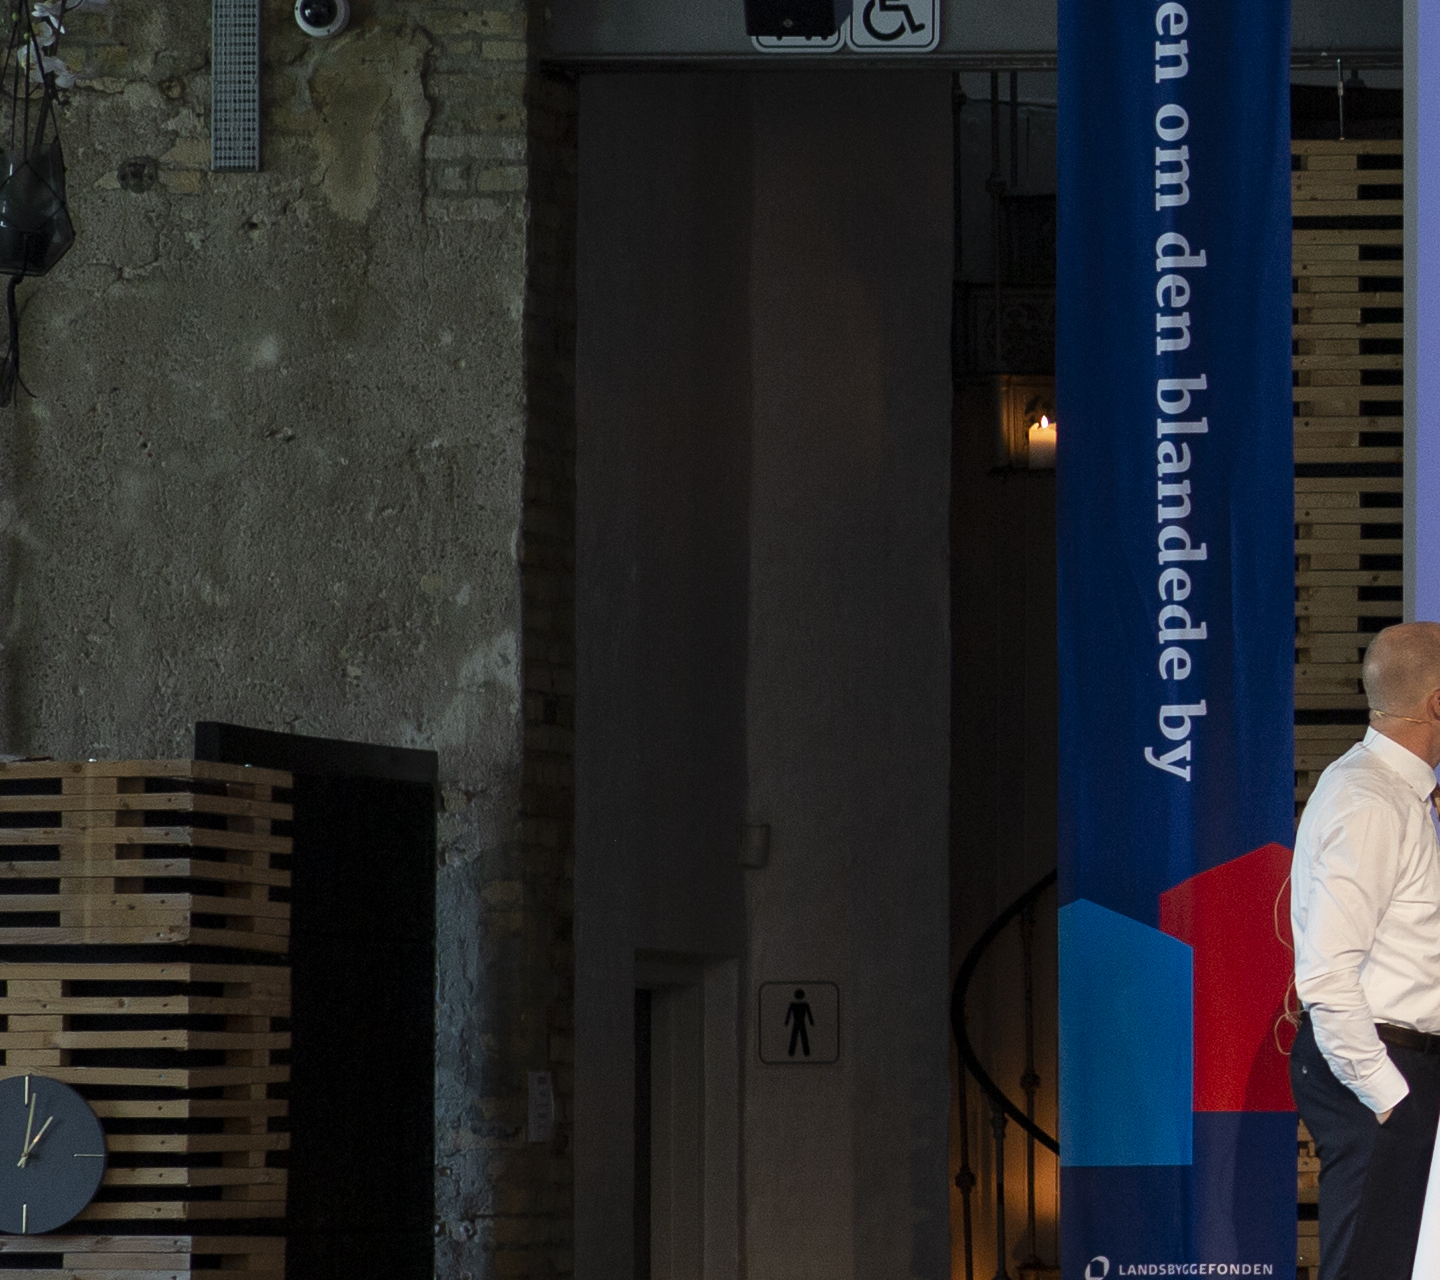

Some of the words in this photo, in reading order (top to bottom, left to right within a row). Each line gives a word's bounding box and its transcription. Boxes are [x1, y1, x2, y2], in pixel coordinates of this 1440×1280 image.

[1154, 102, 1191, 212] om
[1154, 231, 1207, 356] den
[1155, 373, 1209, 681] blandede
[1143, 699, 1208, 783] by
[1118, 1262, 1274, 1276] LANDSBYGGEFONDEN
